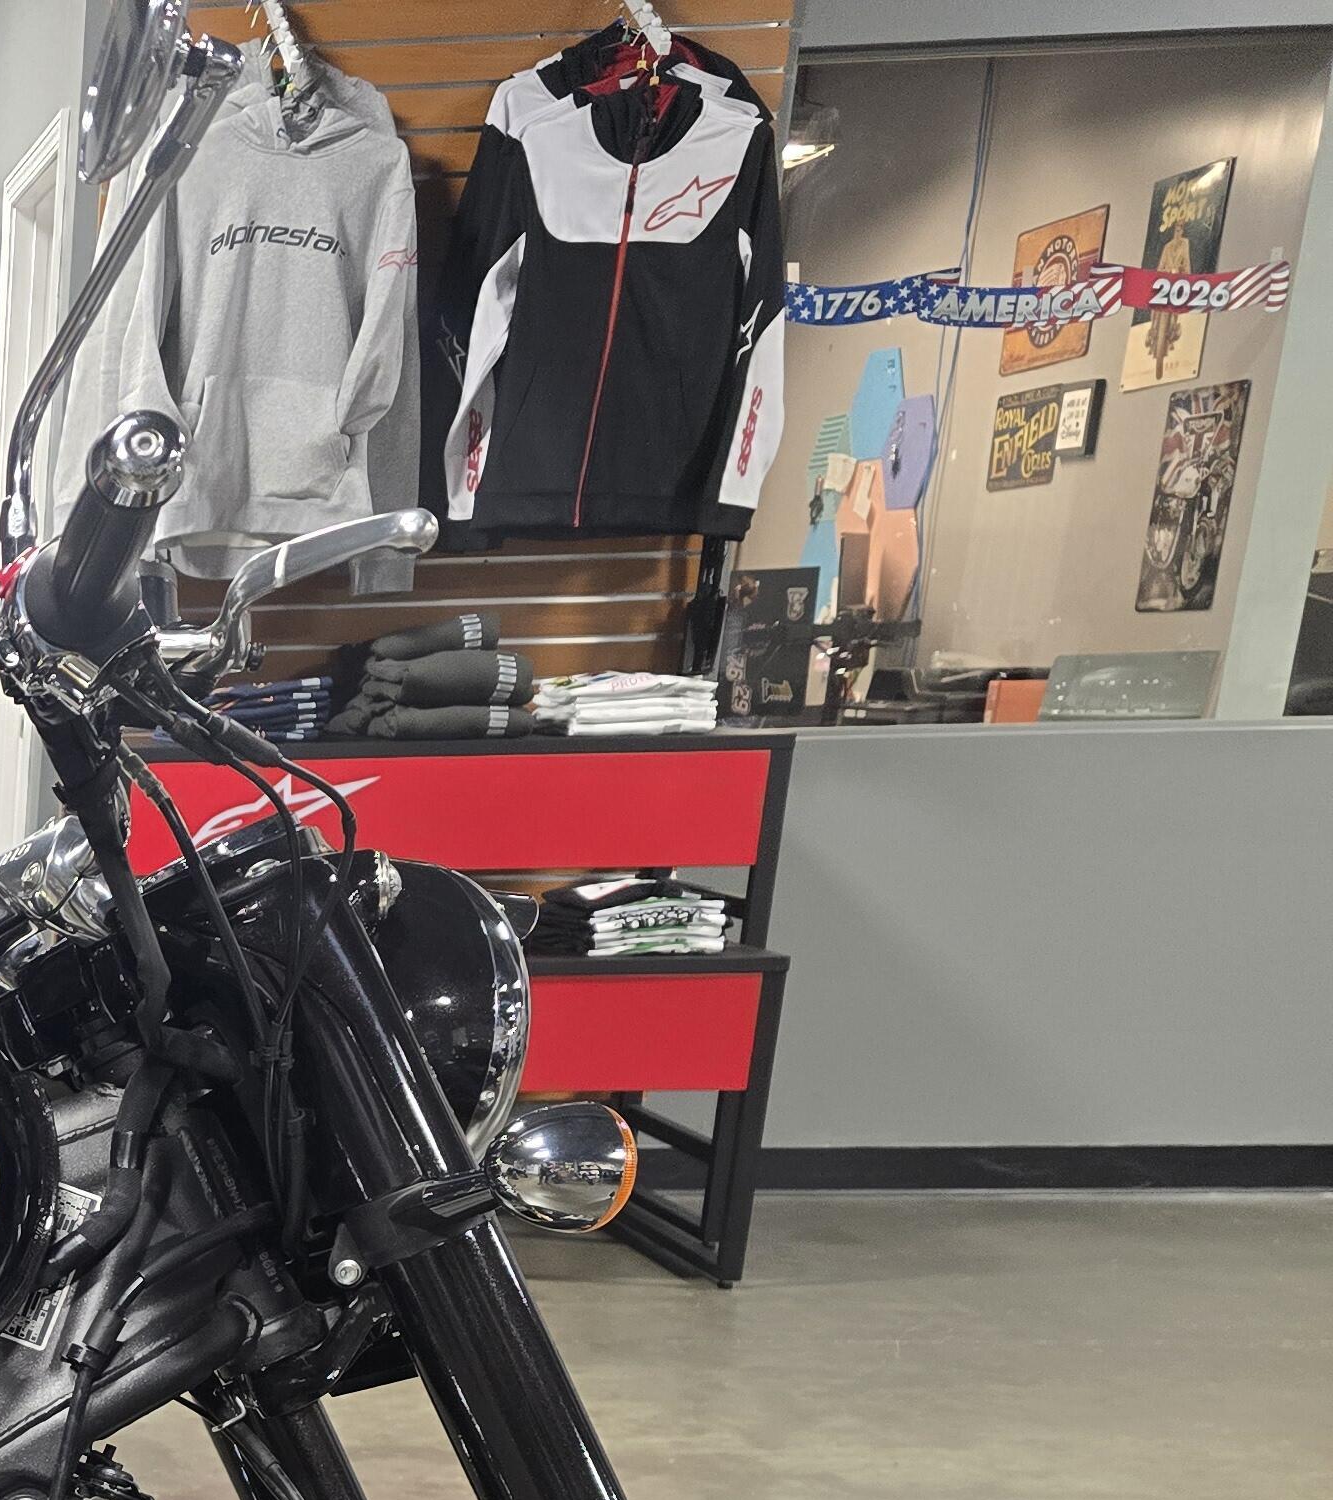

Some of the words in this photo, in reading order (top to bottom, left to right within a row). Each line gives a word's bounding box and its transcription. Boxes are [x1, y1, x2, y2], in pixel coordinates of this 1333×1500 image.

[811, 289, 882, 320] 1776
[933, 284, 1103, 324] AMERICA
[1149, 278, 1230, 307] 2026
[995, 407, 1027, 431] ROYAL
[990, 401, 1059, 480] ENFIELD
